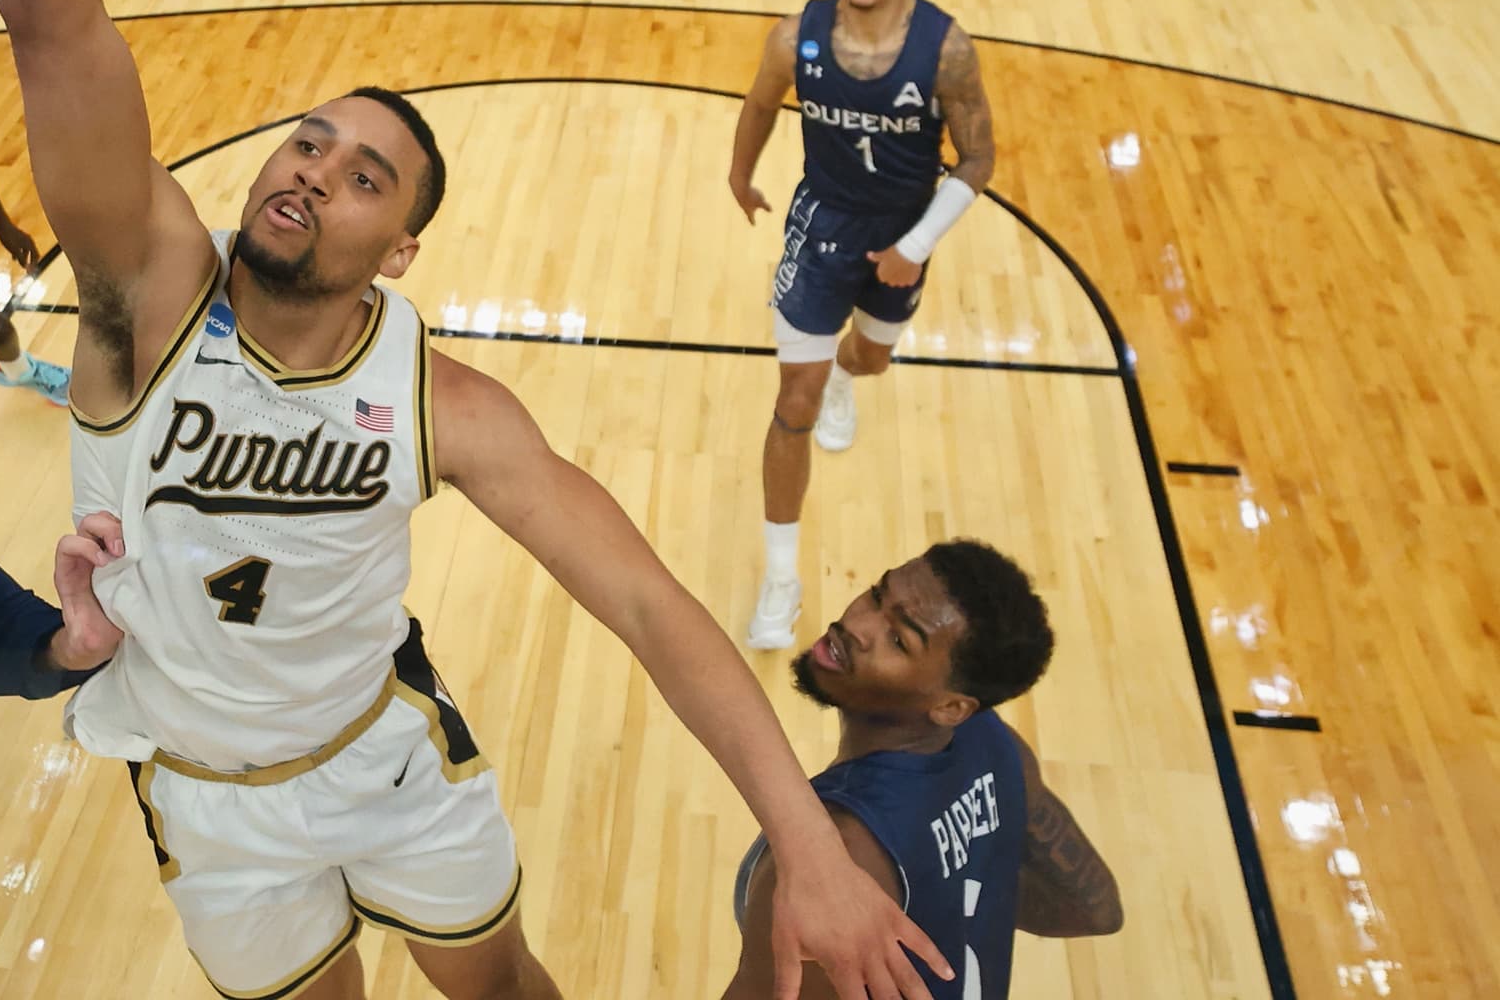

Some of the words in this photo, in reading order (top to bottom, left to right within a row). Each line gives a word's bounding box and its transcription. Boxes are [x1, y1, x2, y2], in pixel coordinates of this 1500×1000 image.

[801, 99, 921, 133] QUEENS
[855, 135, 878, 173] 1
[149, 397, 390, 512] Purdue
[203, 555, 273, 626] 4
